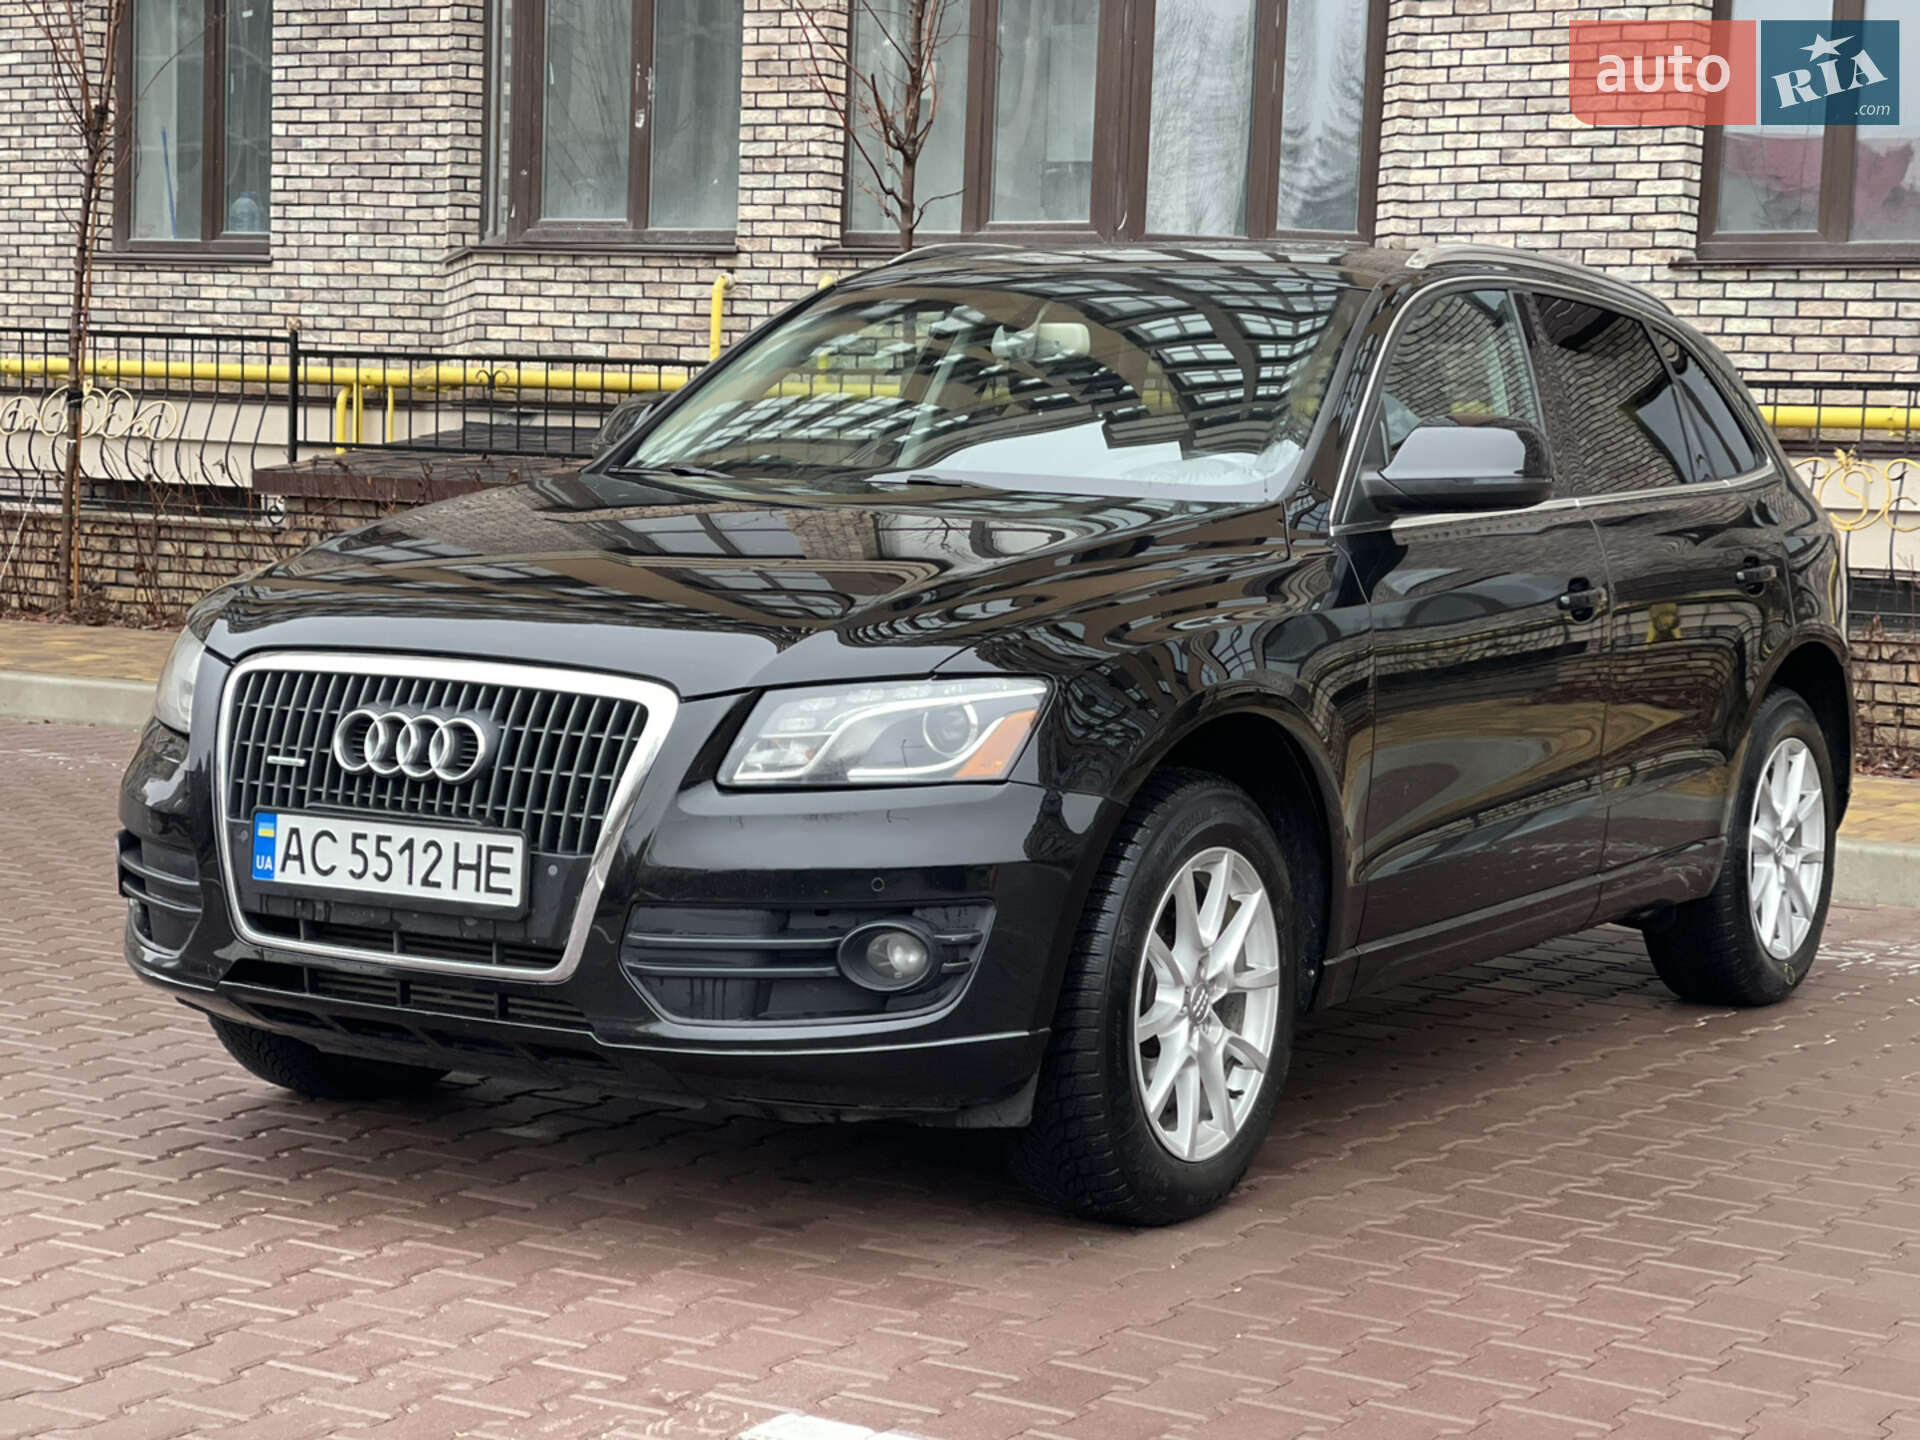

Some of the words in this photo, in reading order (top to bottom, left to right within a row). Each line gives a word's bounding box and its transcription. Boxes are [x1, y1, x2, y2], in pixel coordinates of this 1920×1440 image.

[255, 854, 273, 871] UA
[279, 826, 338, 877] AC
[348, 831, 443, 889] 5512
[452, 841, 514, 896] HE
